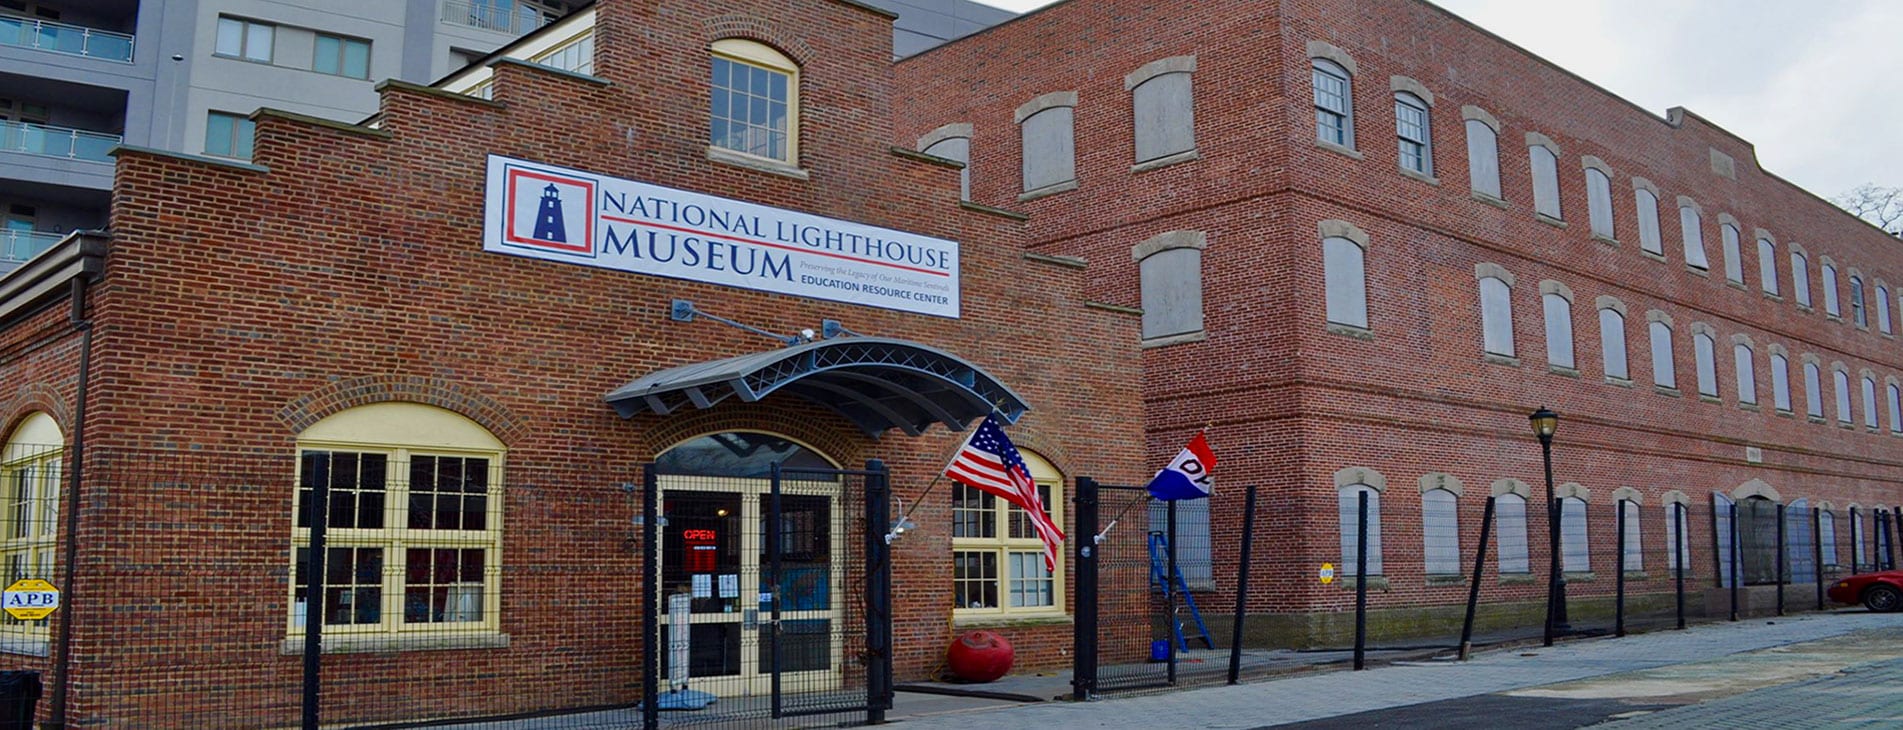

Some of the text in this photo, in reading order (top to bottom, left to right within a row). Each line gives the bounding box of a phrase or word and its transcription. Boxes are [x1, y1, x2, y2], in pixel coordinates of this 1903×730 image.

[602, 190, 950, 270] NATIONAL LIGHTHOUSE
[601, 224, 796, 283] MUSEUM
[800, 260, 836, 275] Preserving
[836, 265, 847, 275] the
[848, 268, 870, 280] Legacy
[879, 273, 892, 282] Our
[801, 274, 949, 305] EDUCATION RESOURCE CENTER
[683, 529, 717, 540] OPEN
